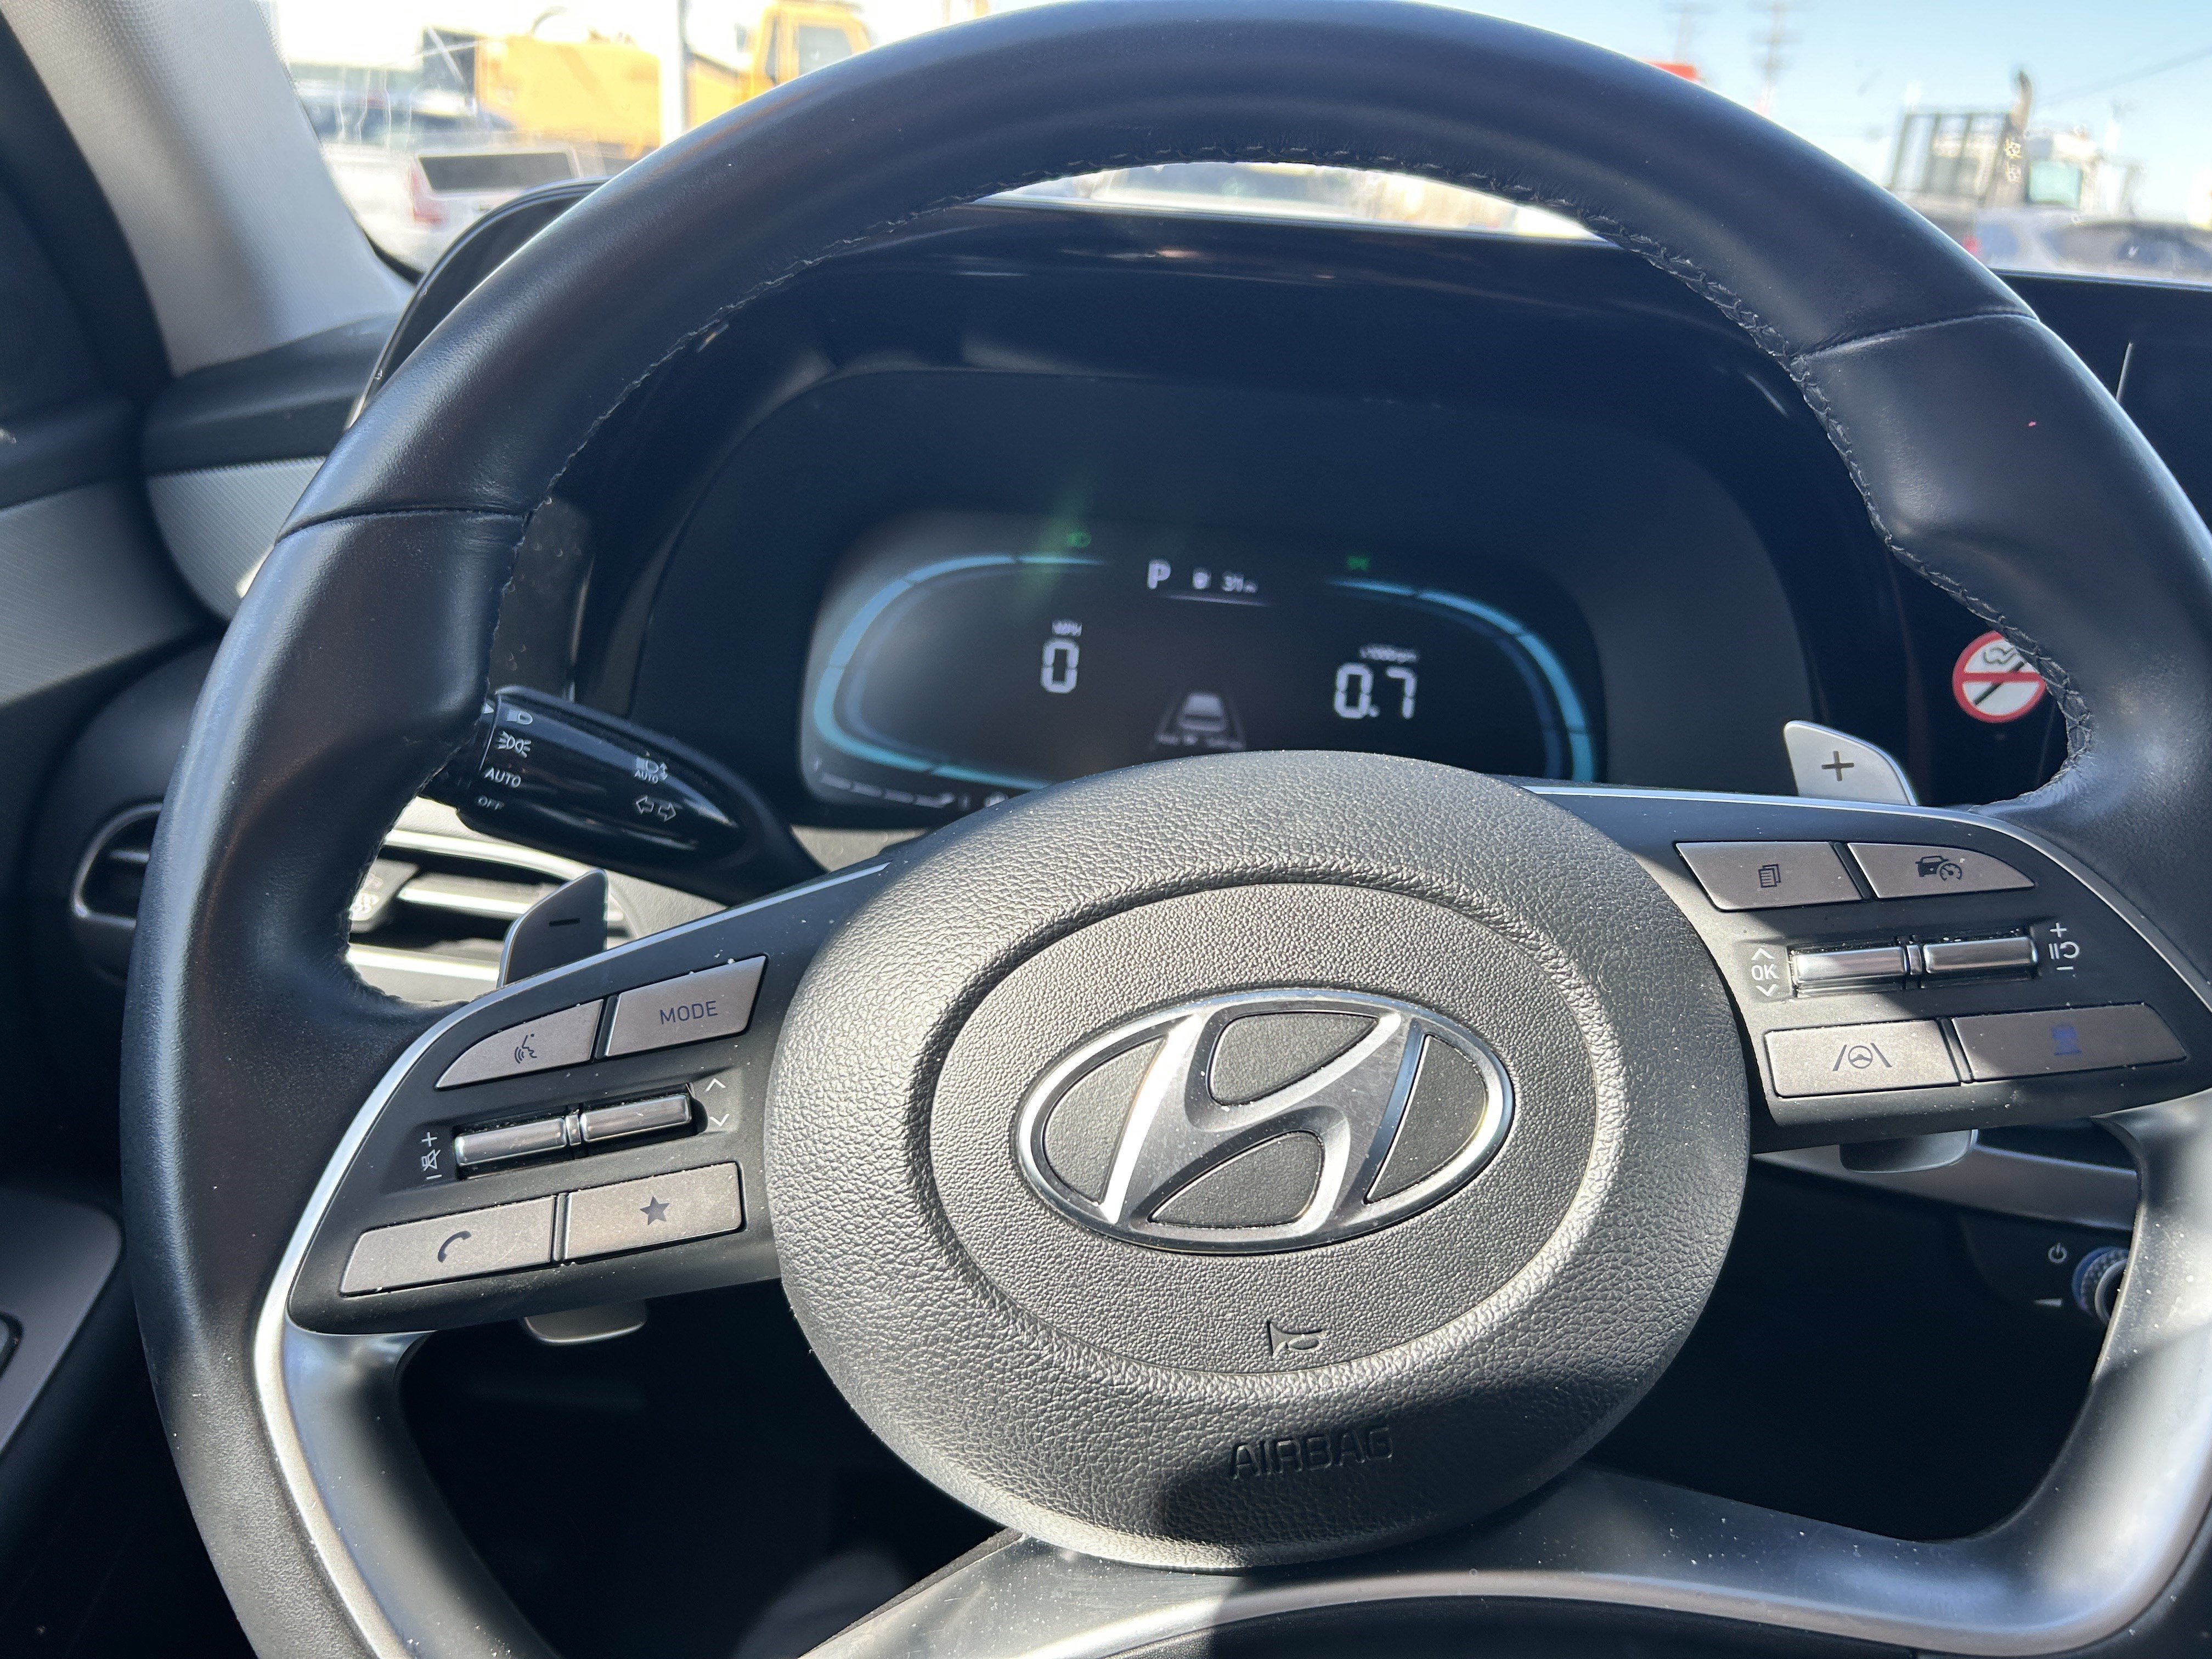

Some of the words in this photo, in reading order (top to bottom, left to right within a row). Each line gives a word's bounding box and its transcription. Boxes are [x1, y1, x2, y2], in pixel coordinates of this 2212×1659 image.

[1147, 558, 1171, 590] P
[1041, 638, 1080, 694] 0
[1334, 663, 1418, 720] 0.7
[484, 767, 522, 788] AUTO
[634, 769, 659, 784] AUTO
[477, 795, 505, 810] OFF
[1751, 963, 1779, 981] OK
[659, 1000, 718, 1025] MODE
[1232, 1425, 1393, 1480] AIRBAG
